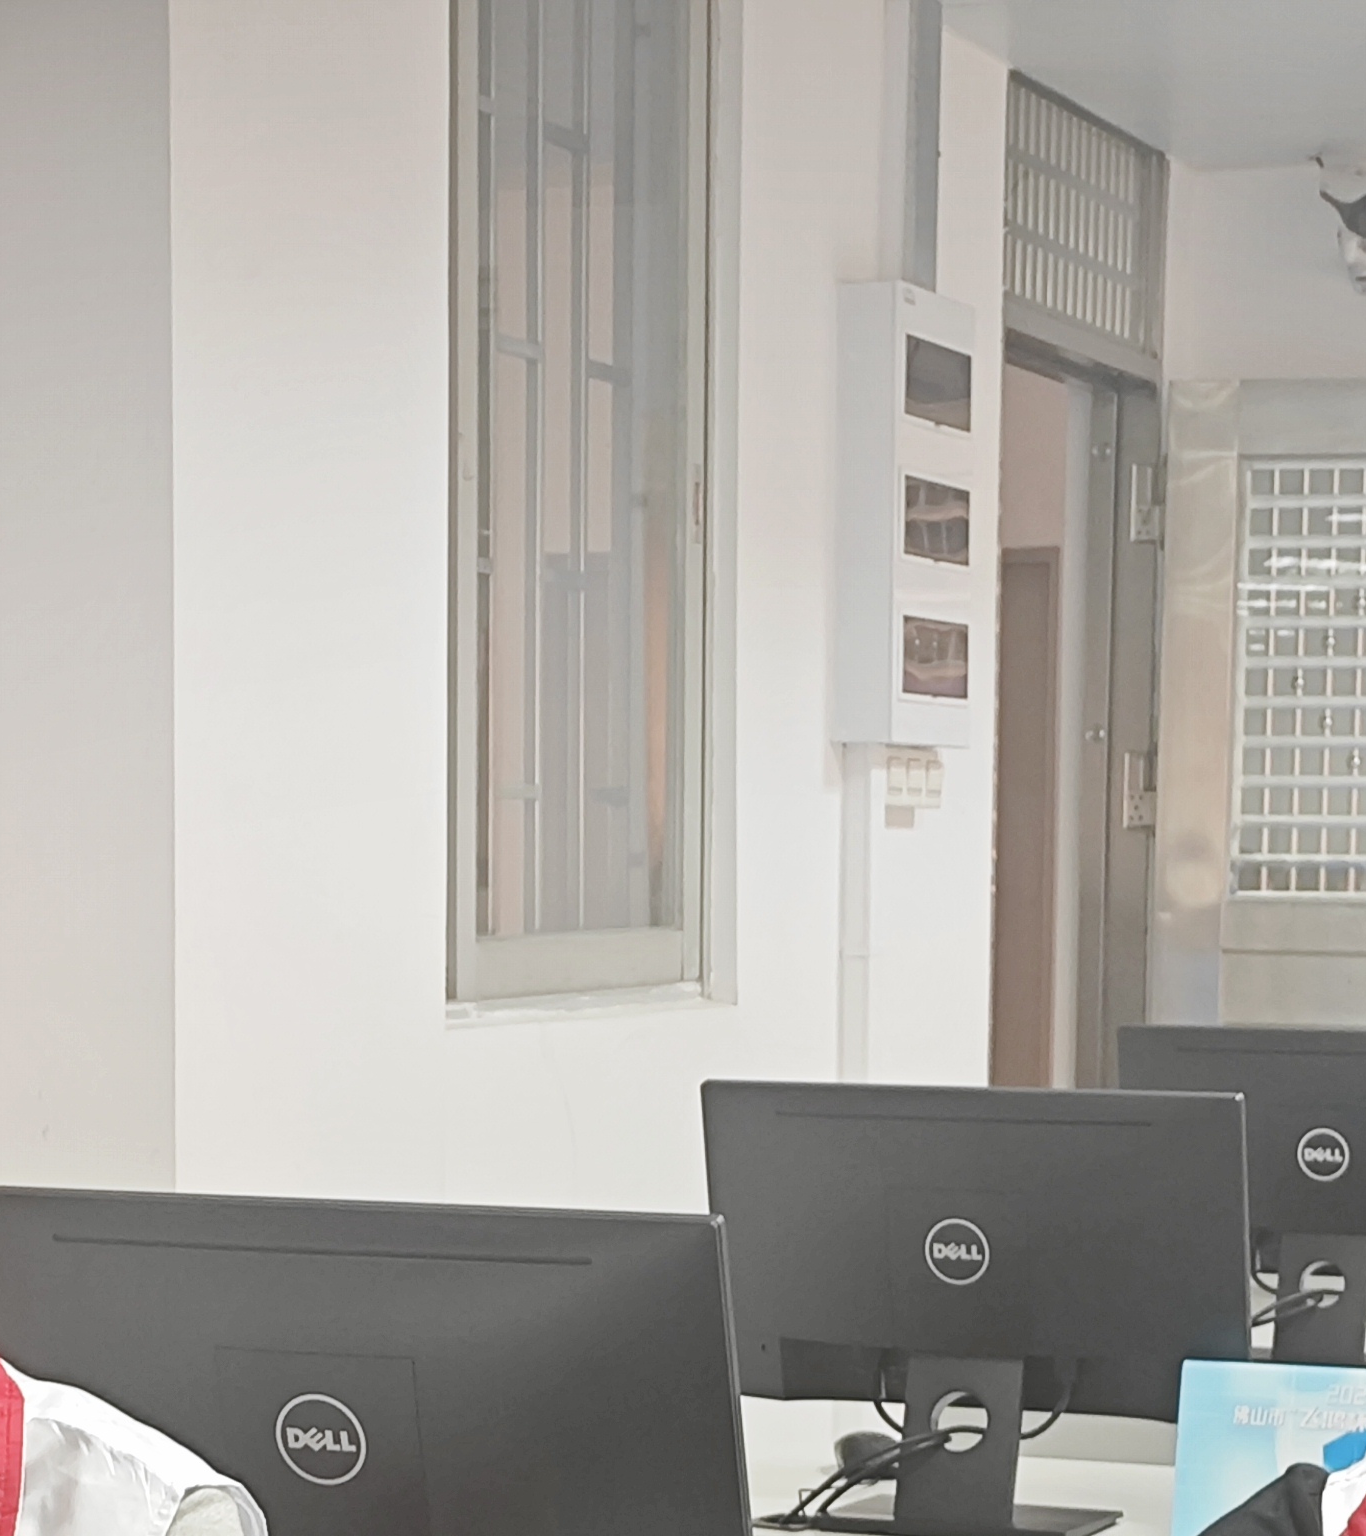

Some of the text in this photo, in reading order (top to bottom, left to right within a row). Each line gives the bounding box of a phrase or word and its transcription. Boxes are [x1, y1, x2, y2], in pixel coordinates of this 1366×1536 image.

[1303, 1146, 1344, 1163] DELL
[932, 1242, 983, 1261] DELL
[286, 1427, 357, 1452] DELL
